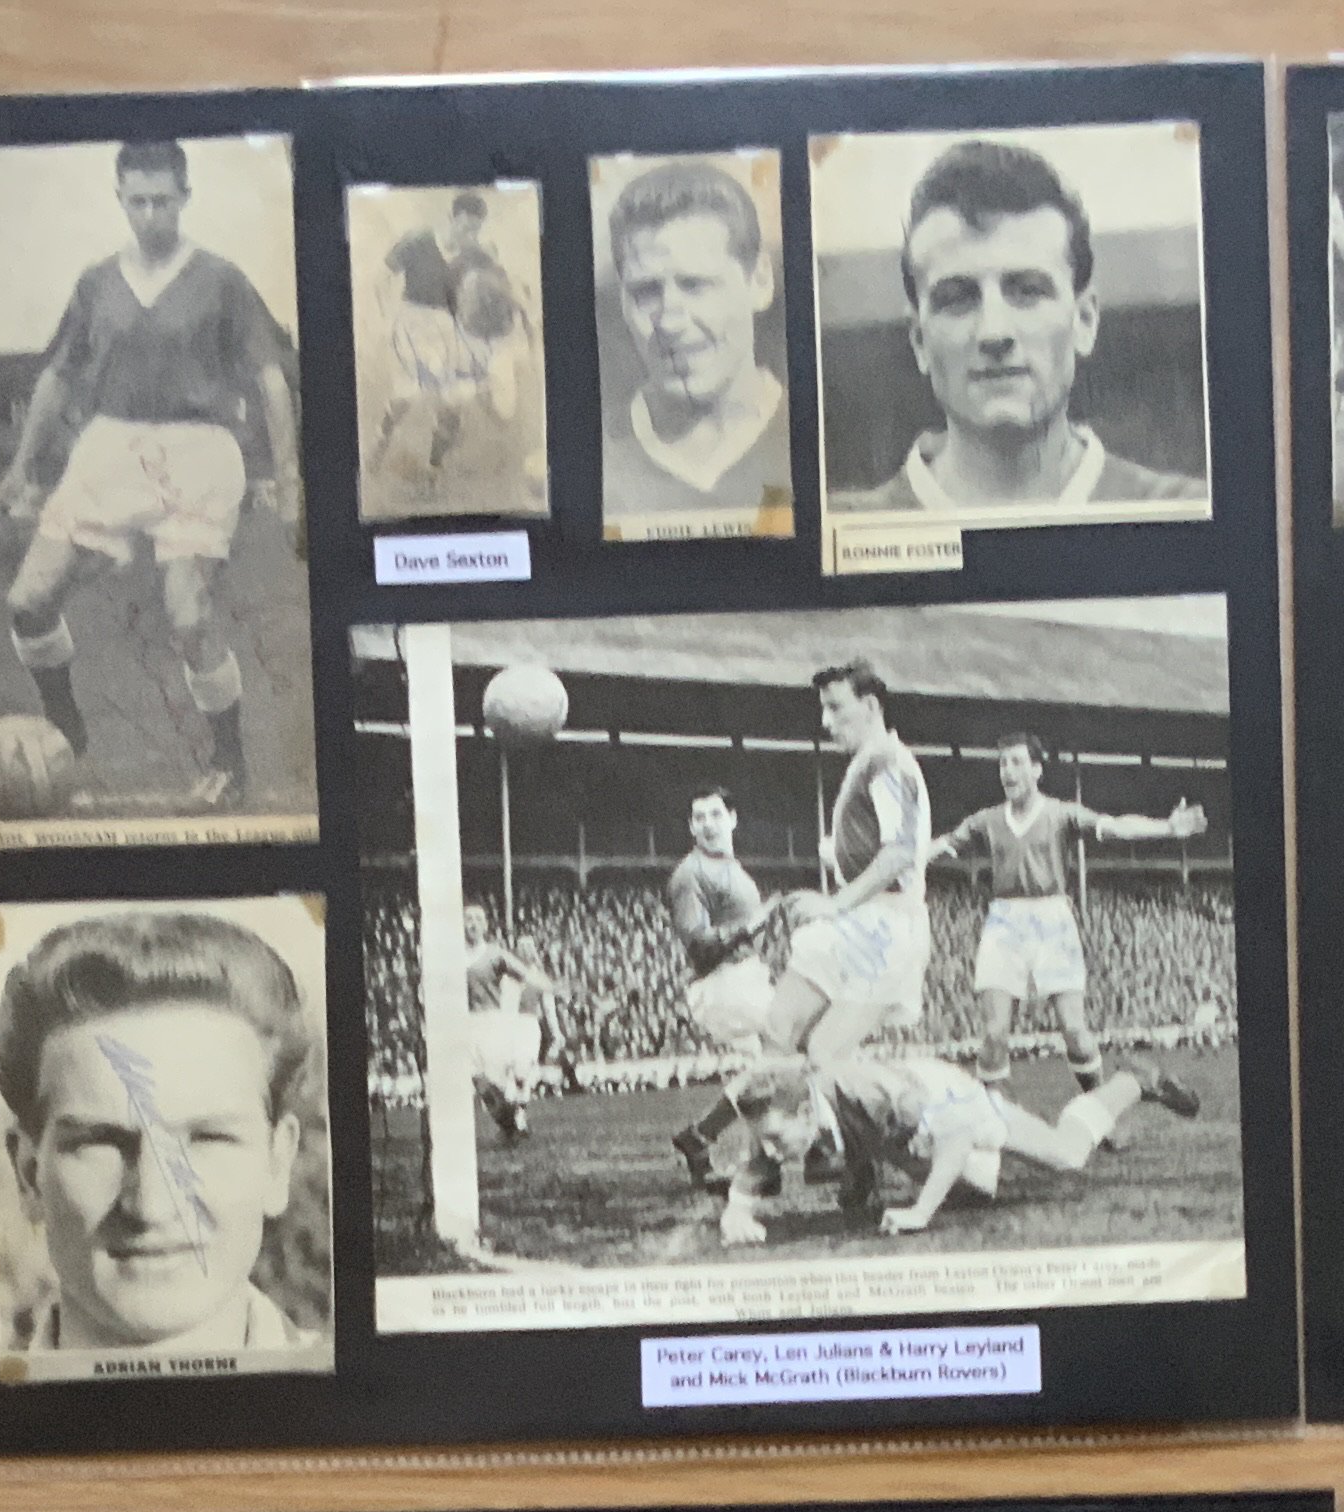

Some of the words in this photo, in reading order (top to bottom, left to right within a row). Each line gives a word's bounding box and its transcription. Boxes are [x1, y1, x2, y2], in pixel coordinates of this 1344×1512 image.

[394, 551, 440, 570] Dave
[446, 548, 509, 568] Sexton
[842, 544, 901, 559] RONNIE
[906, 542, 961, 558] FOSTER
[657, 1347, 704, 1364] Peter
[711, 1346, 767, 1365] Carey,
[775, 1345, 808, 1361] Len
[814, 1343, 873, 1360] Julians
[880, 1341, 892, 1357] &
[899, 1339, 948, 1360] Harry
[955, 1337, 1024, 1357] Leyland
[94, 1360, 161, 1374] ADRIAN
[169, 1357, 238, 1373] THORNE
[670, 1371, 703, 1388] and
[709, 1369, 747, 1387] Mick
[754, 1367, 831, 1386] McGrath
[836, 1366, 932, 1387] (Blackburn
[937, 1362, 1007, 1381] Rovers)
